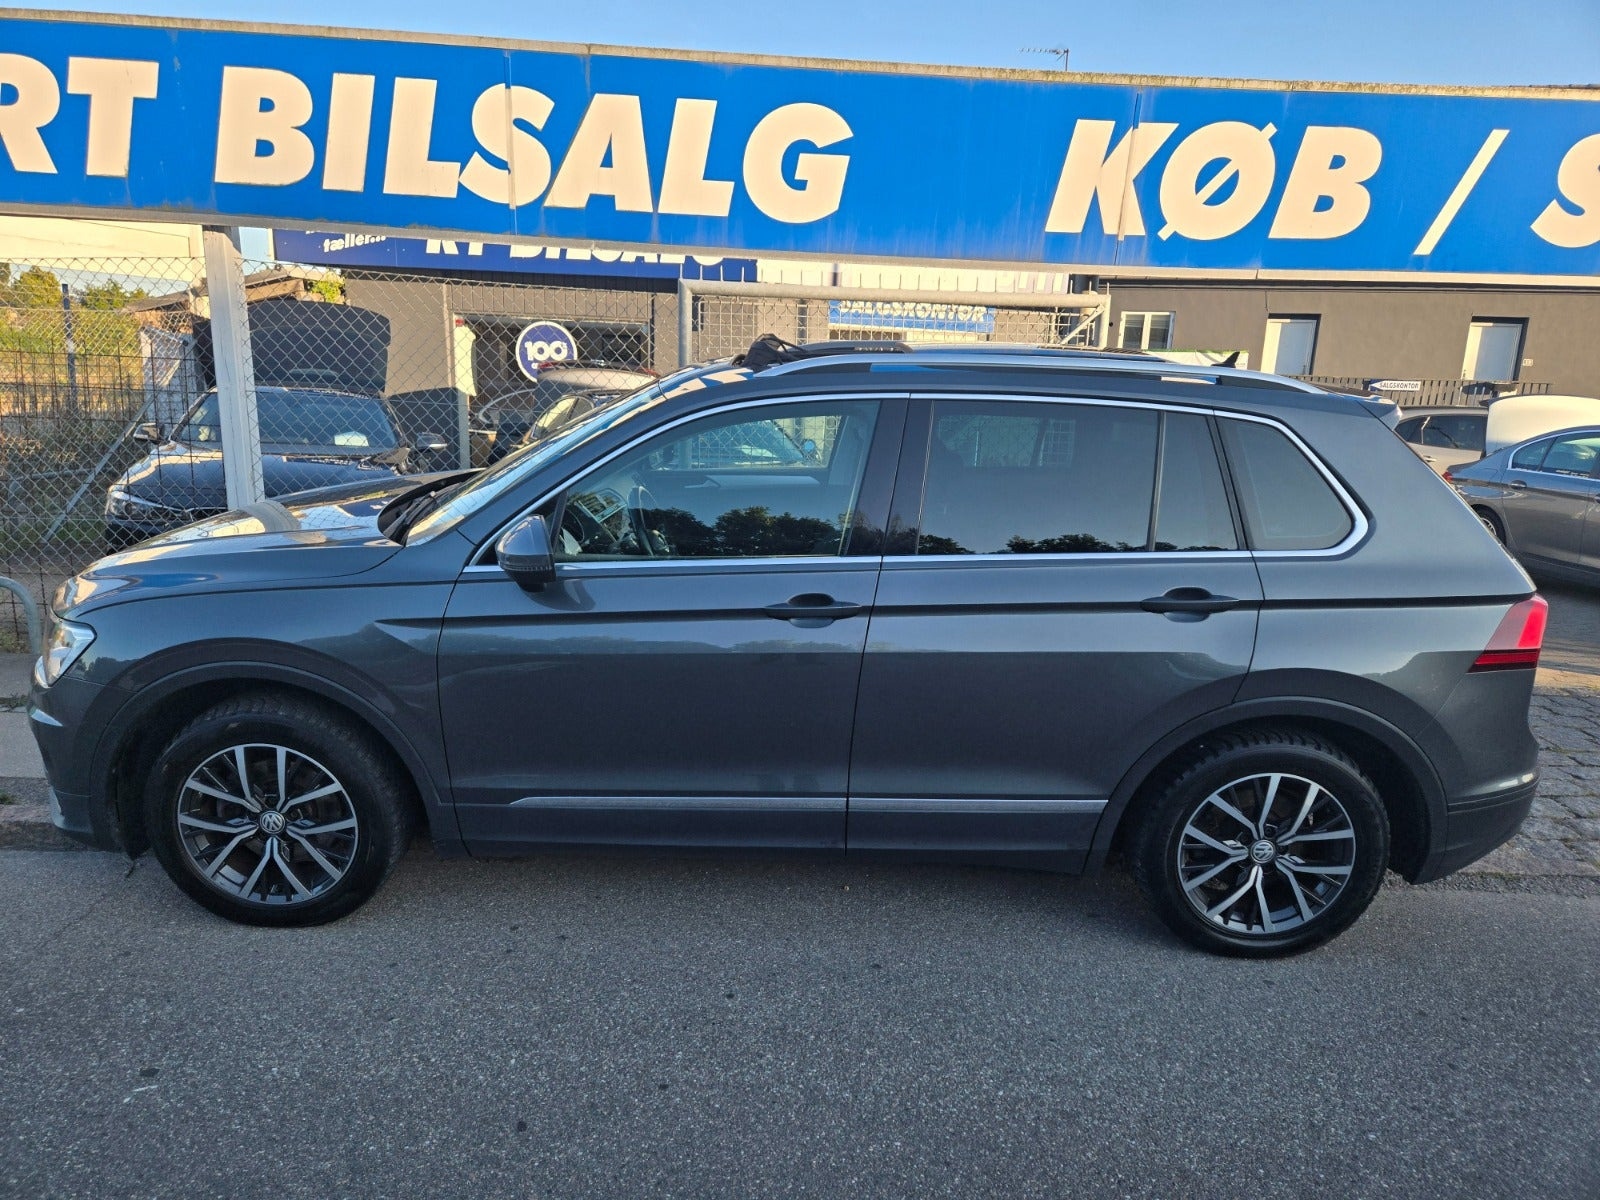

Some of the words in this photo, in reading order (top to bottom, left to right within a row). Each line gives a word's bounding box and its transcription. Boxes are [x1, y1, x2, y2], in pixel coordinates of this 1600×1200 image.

[0, 53, 159, 178] RT
[214, 66, 853, 224] BILSALG
[1044, 119, 1383, 241] KØB
[1412, 129, 1510, 256] /
[1379, 381, 1419, 390] SALGSKONTOR
